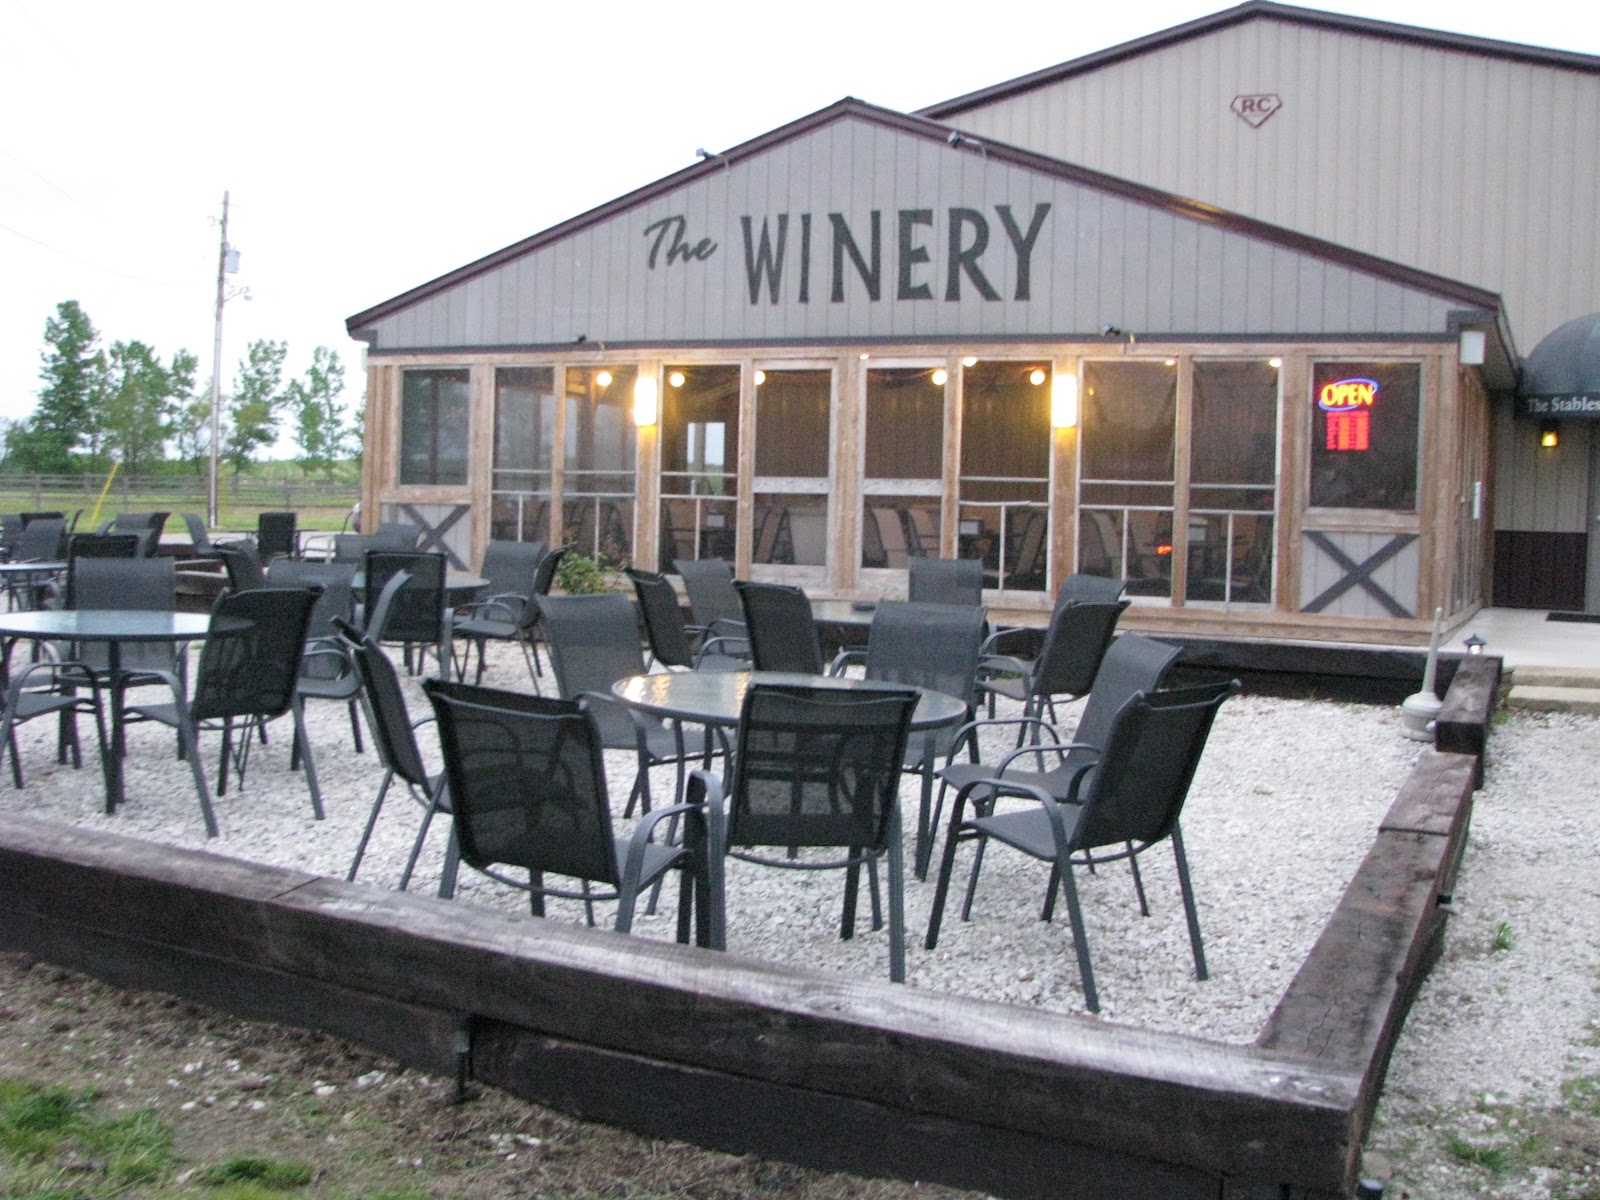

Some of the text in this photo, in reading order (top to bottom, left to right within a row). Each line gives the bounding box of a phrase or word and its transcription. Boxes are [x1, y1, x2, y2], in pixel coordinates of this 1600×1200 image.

[1241, 97, 1272, 112] RC
[643, 203, 1052, 305] The WINERY
[1321, 384, 1373, 406] OPEN
[1528, 398, 1549, 413] The
